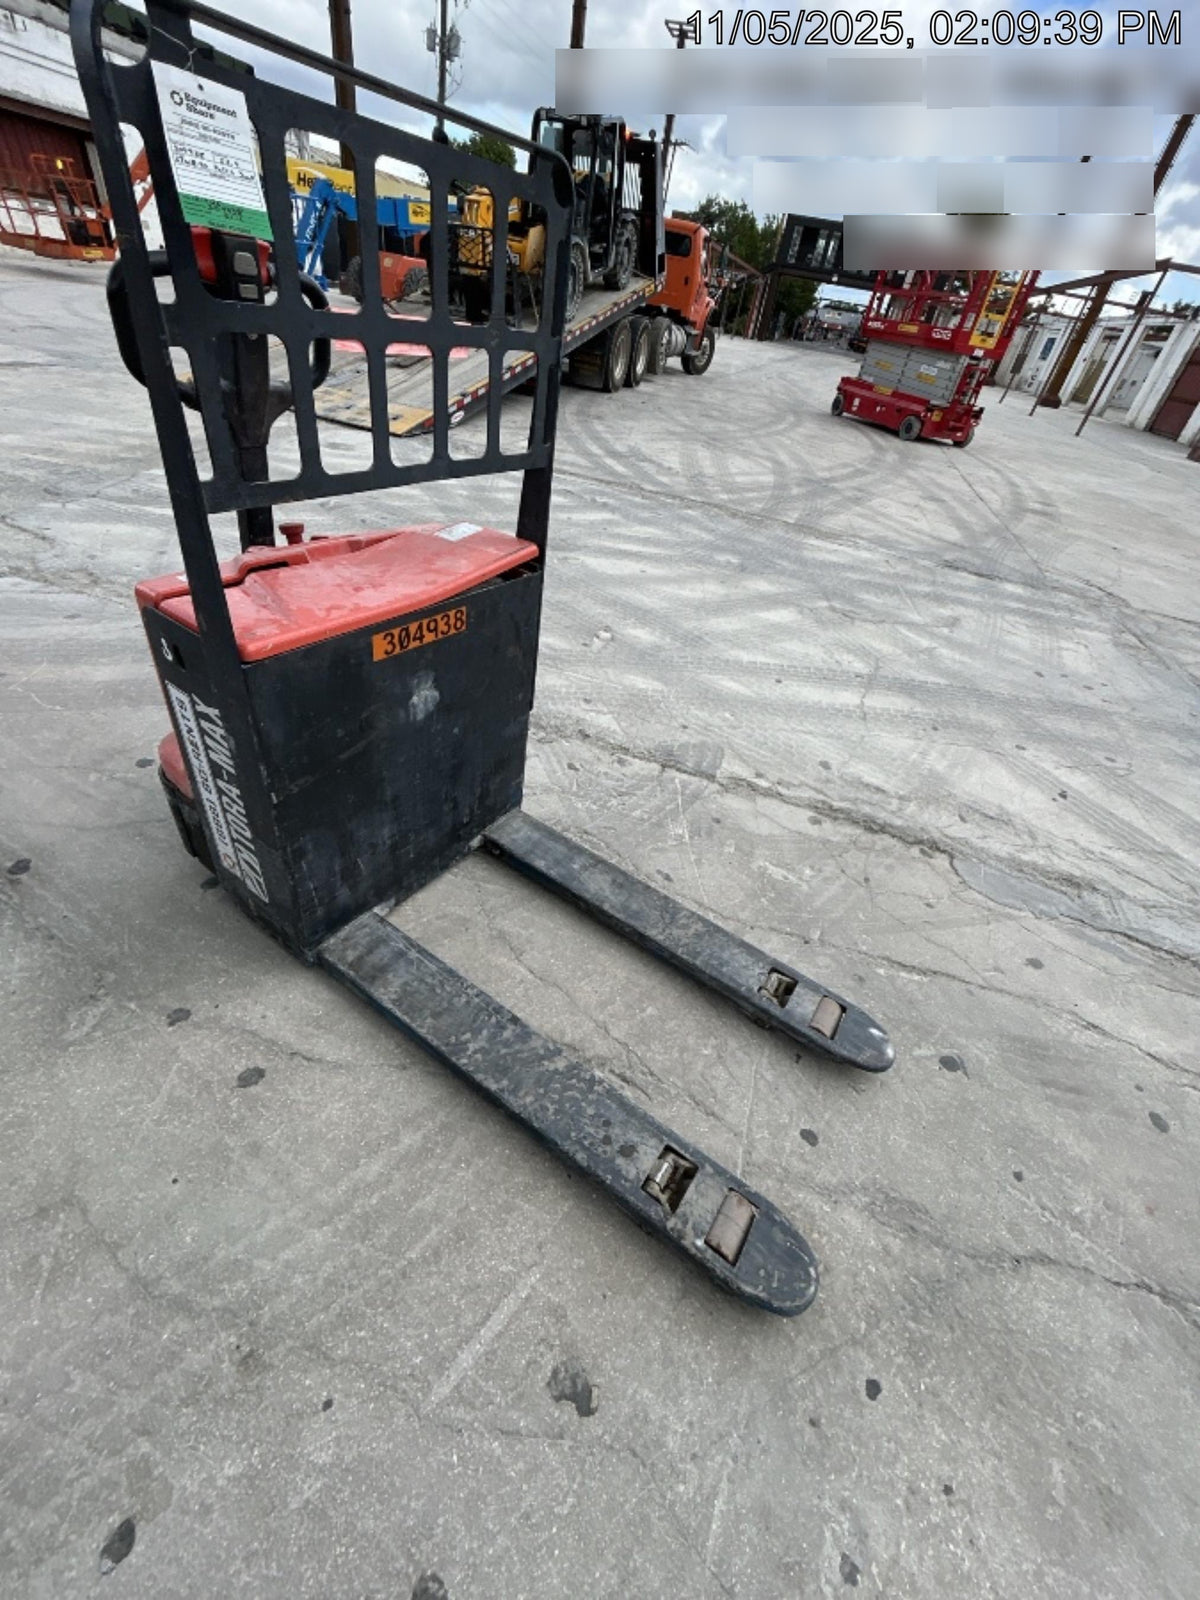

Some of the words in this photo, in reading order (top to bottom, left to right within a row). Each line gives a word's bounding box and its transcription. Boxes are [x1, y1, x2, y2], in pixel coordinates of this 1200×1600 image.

[184, 92, 237, 117] Equipment
[185, 103, 216, 119] Share
[383, 609, 465, 656] 304938
[191, 692, 255, 851] TORA-MAX
